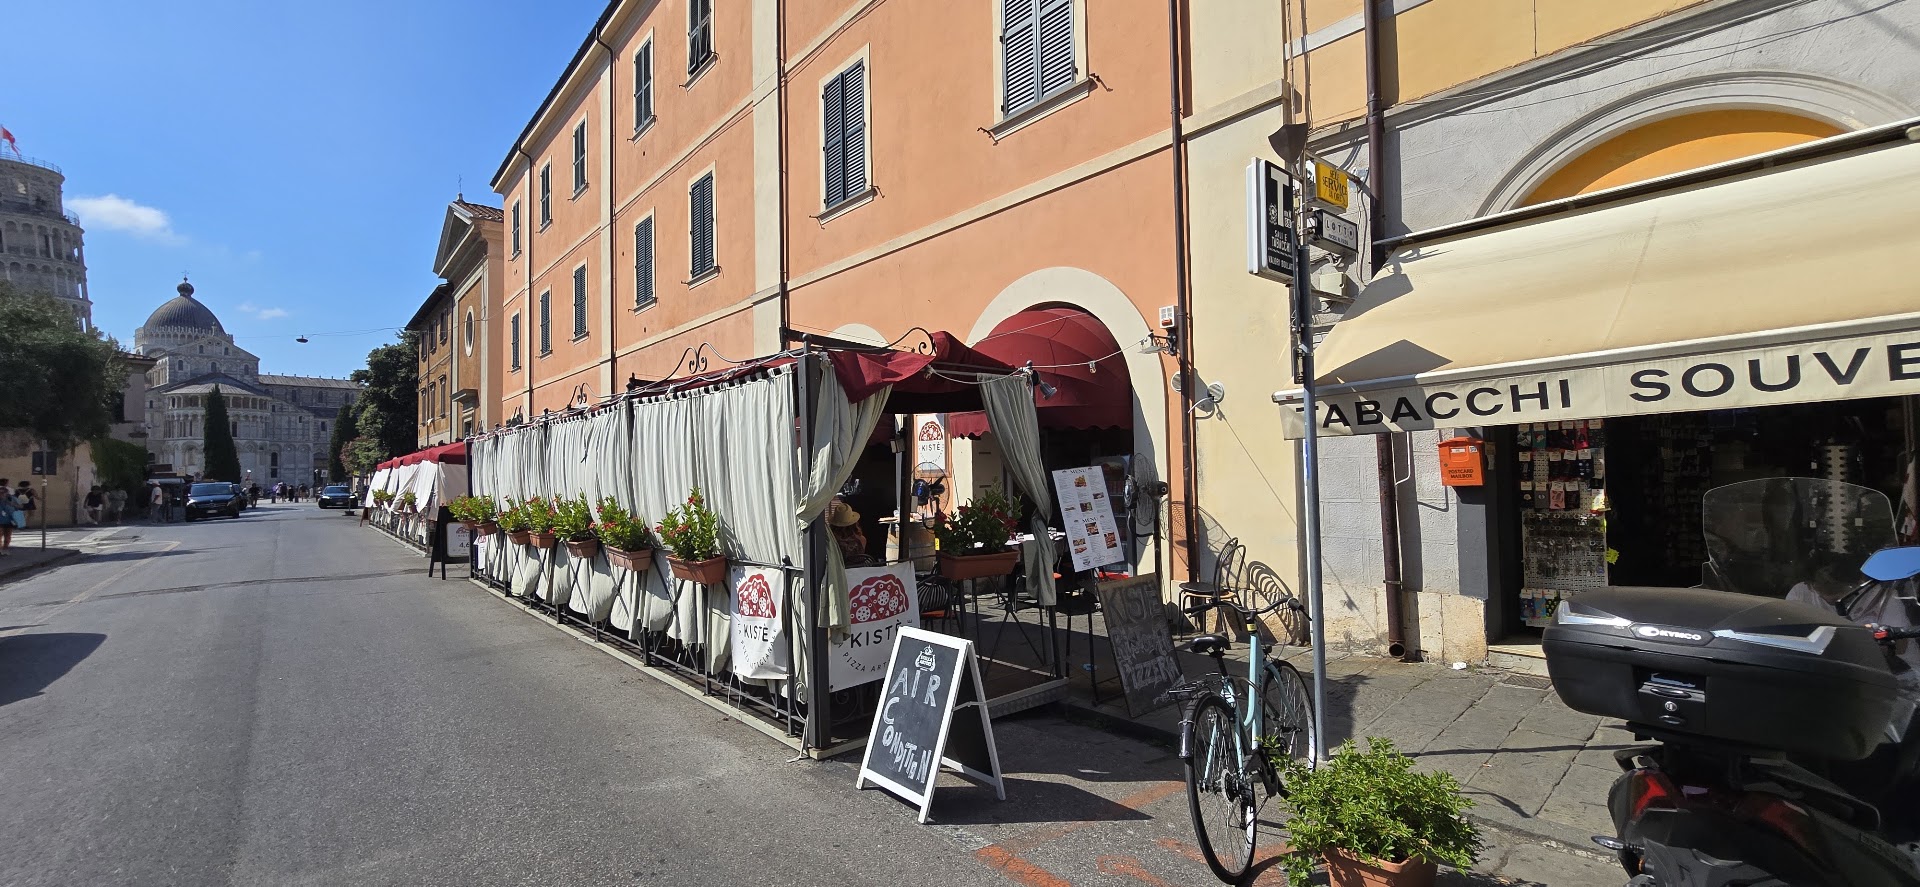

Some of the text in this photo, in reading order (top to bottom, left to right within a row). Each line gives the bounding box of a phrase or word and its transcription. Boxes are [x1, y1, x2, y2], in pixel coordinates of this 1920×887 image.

[1322, 176, 1348, 196] SERVICE
[1270, 166, 1289, 228] T
[1326, 219, 1353, 236] LOTTO
[1281, 259, 1294, 271] BOLLAT
[743, 623, 769, 642] KISTÈ
[1659, 630, 1701, 641] KYMCO
[842, 651, 866, 673] PIZZA
[889, 667, 941, 708] AIR
